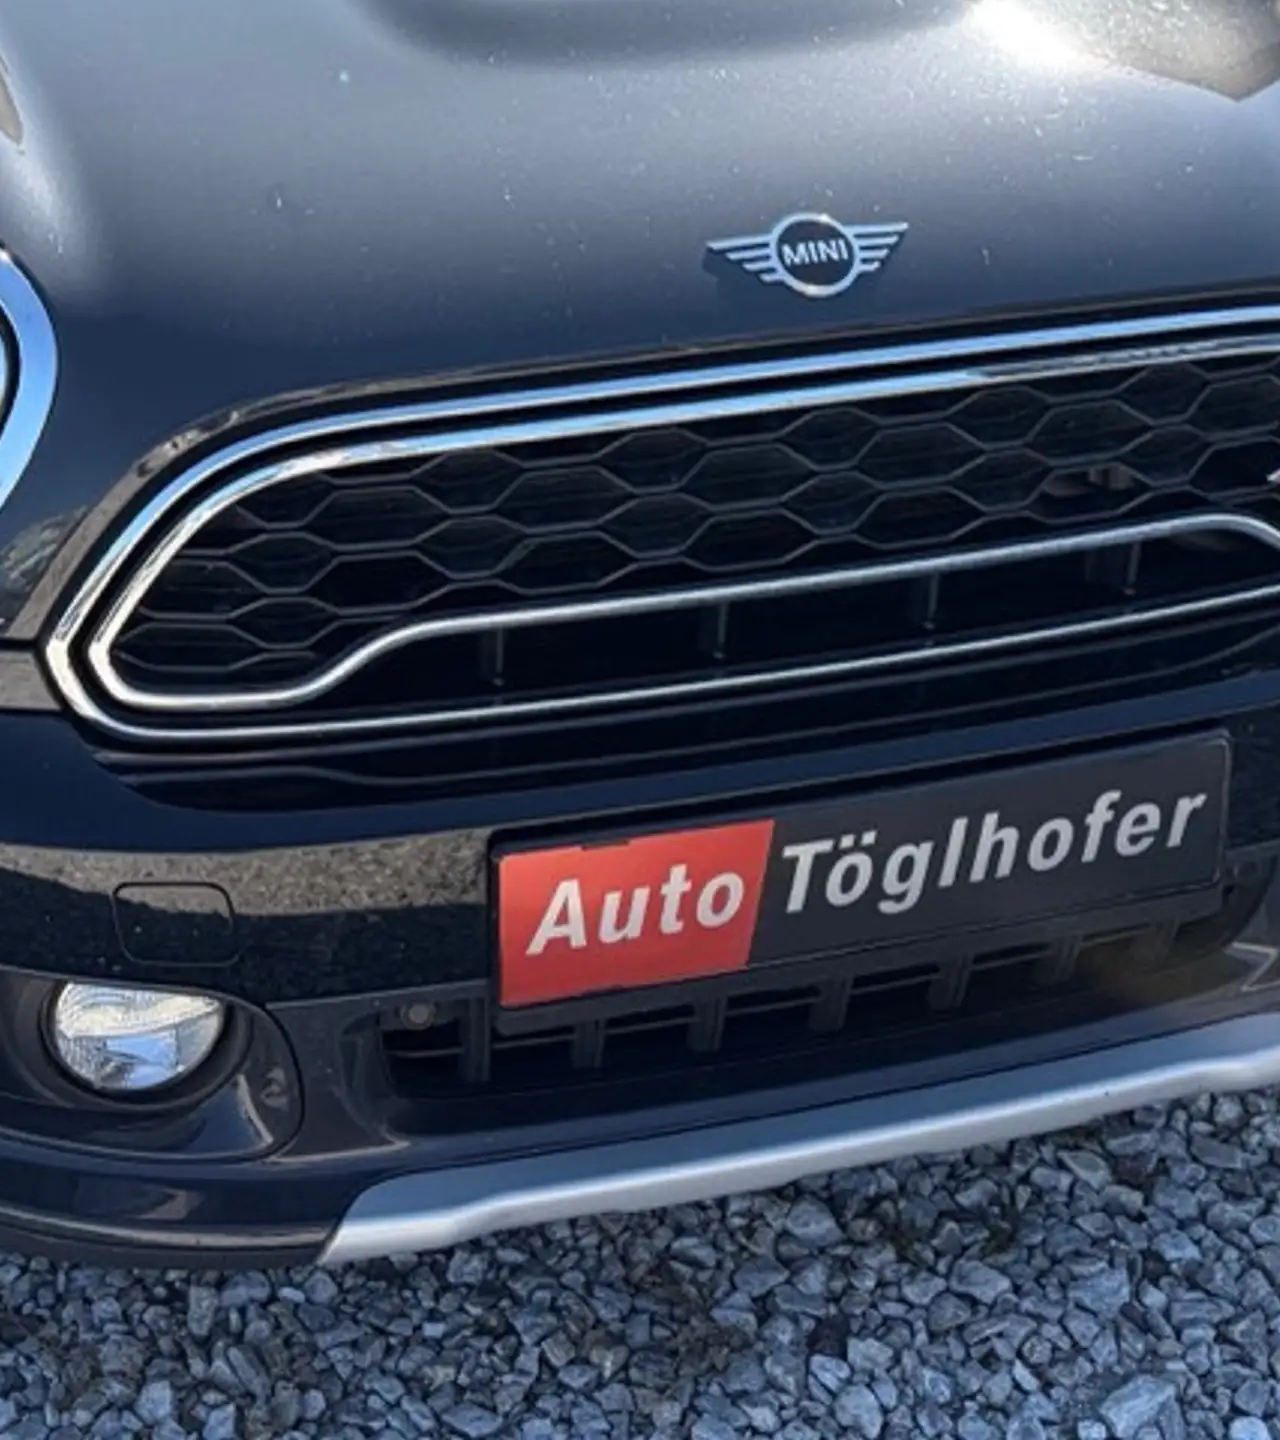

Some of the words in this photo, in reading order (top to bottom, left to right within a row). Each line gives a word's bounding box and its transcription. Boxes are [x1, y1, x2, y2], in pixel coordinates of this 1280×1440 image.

[780, 238, 849, 265] MINI
[526, 862, 745, 956] Auto
[780, 789, 1209, 916] Töglhofer
